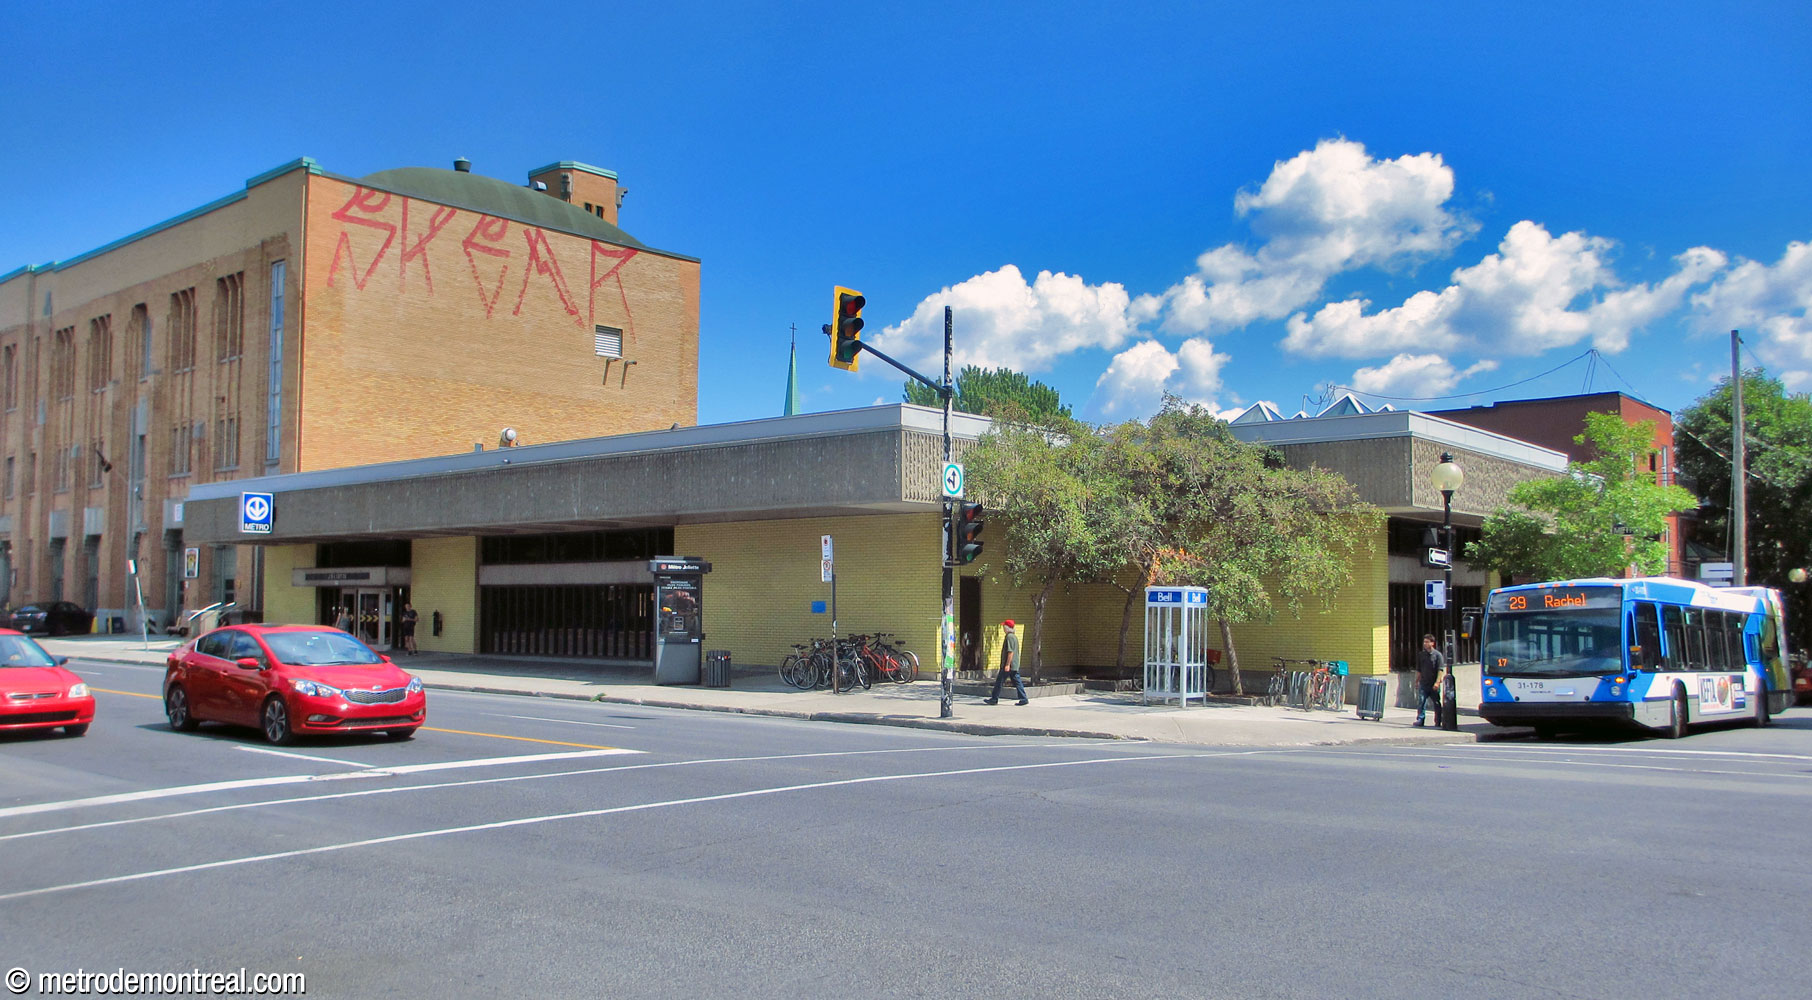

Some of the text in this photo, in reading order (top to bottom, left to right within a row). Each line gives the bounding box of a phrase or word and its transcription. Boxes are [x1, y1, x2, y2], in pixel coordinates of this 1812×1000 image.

[1157, 592, 1173, 602] Bell
[1509, 593, 1586, 610] 29 Rachel
[1498, 658, 1508, 667] 17
[1517, 681, 1544, 689] 31-178
